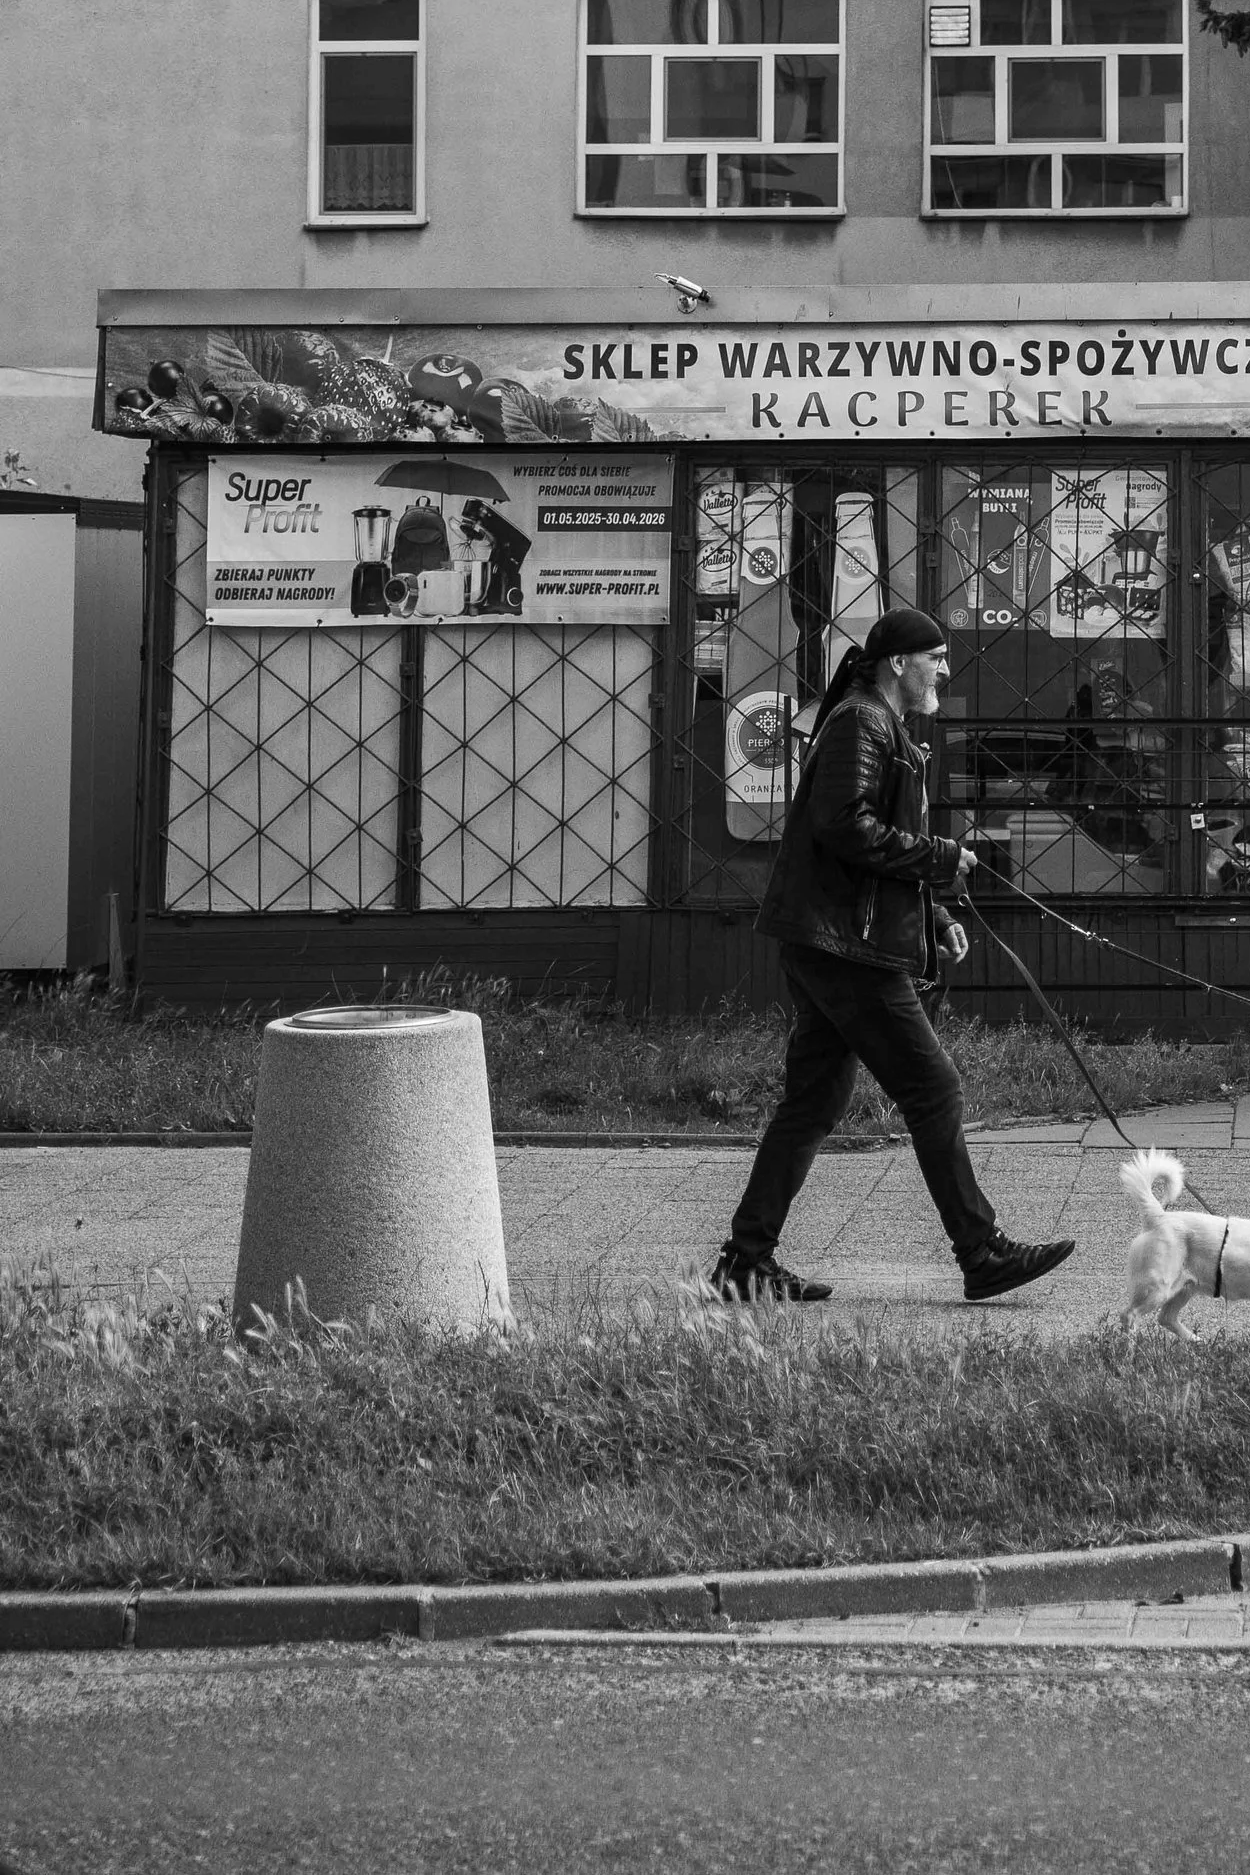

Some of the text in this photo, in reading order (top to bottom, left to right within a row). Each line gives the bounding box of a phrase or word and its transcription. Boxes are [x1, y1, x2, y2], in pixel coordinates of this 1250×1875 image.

[563, 343, 699, 380] SKLEP
[752, 390, 1113, 428] KACPEREK
[513, 463, 632, 477] WYBIERZ COŚ DLA SIEBIE
[225, 472, 312, 505] Super
[538, 485, 657, 499] PROMOCJA OBOWIĄZUJE
[968, 488, 1031, 499] WYMIANA
[1066, 492, 1107, 509] Profit
[244, 503, 323, 534] Profit
[543, 512, 665, 525] 01.05.2025-30.04.2026
[214, 568, 315, 582] ZBIERAJ PUNKTY
[539, 569, 658, 577] ZOBACZ WSZYSTKIE NAGRODY NA STRONIE
[215, 587, 335, 601] ODBIERAJ NAGRODY!
[536, 583, 660, 596] WWW.SUPER-PROFIT.PL
